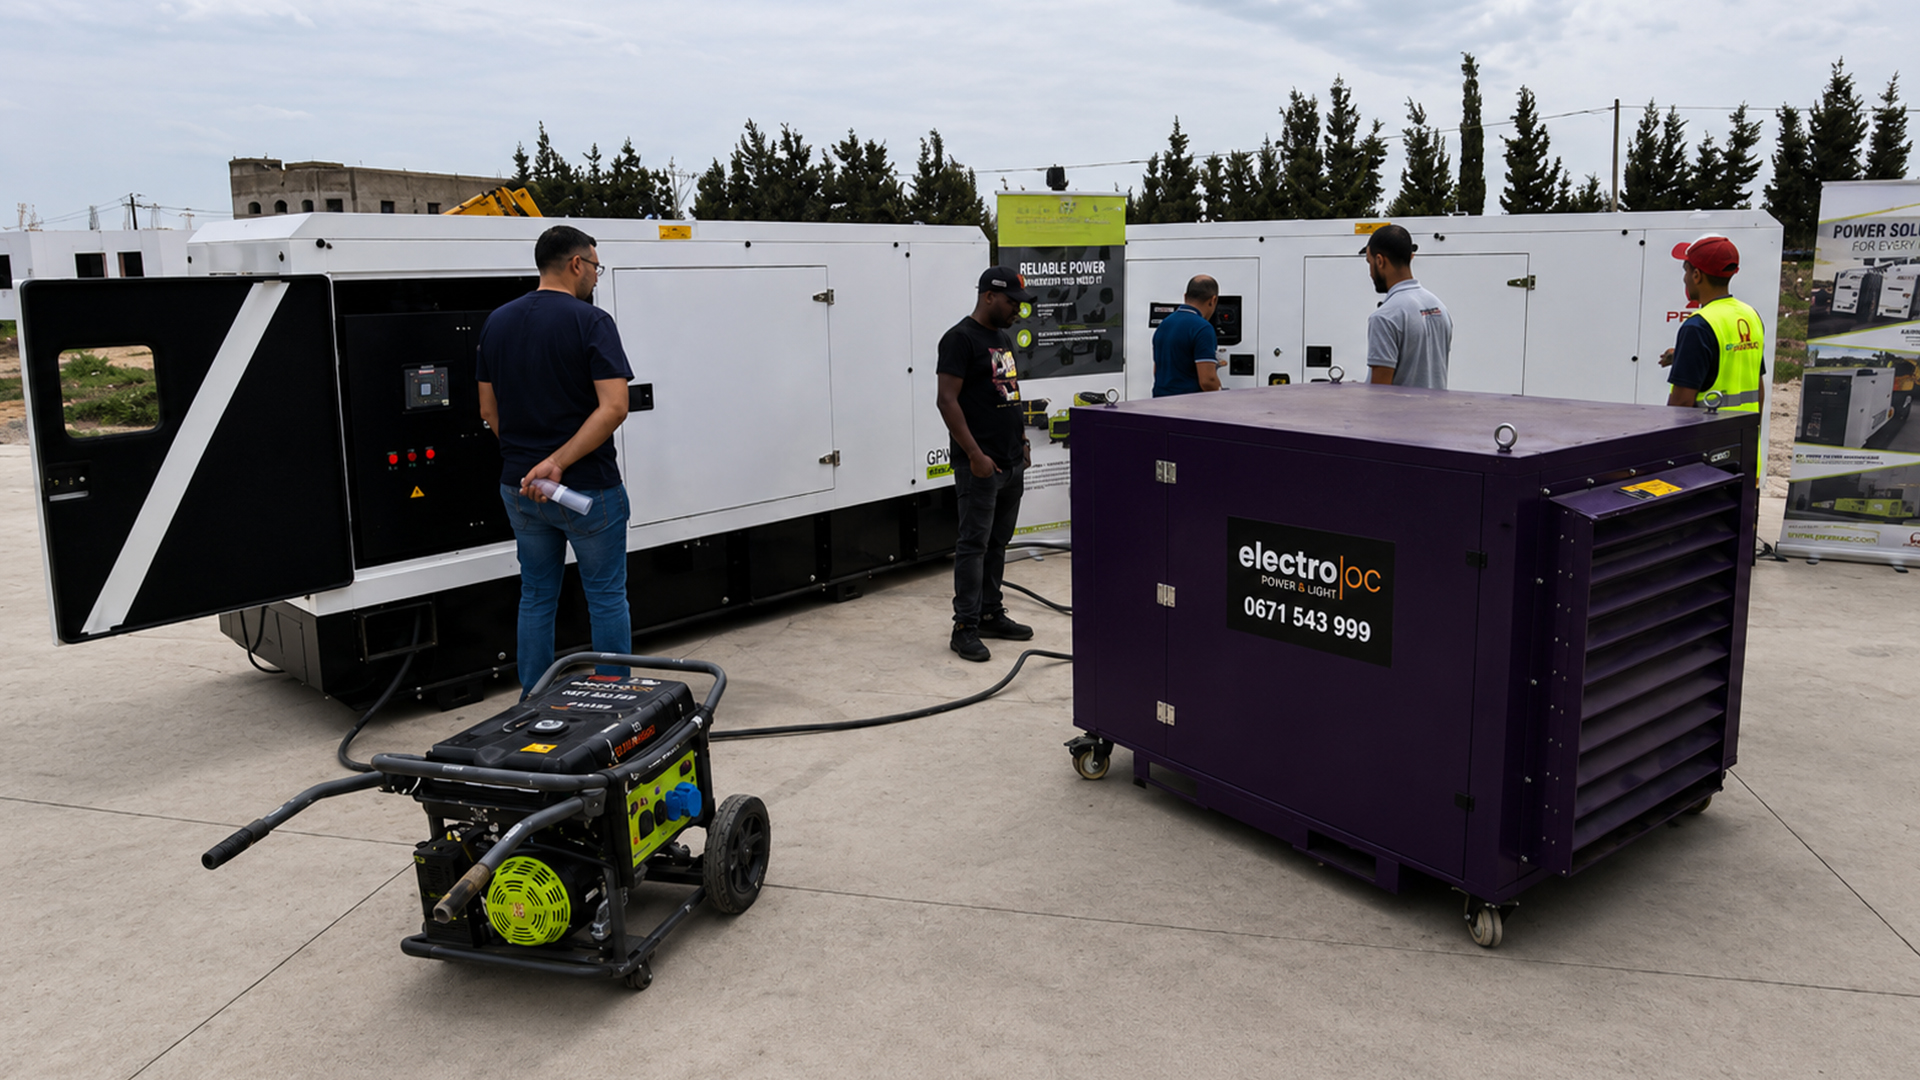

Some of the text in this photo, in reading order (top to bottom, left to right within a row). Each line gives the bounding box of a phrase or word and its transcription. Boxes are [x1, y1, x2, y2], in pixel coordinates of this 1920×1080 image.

[1833, 222, 1920, 239] POWER SOL
[1852, 240, 1916, 252] FOR EVERY
[1020, 261, 1106, 275] RELIABLE POWER
[1261, 575, 1296, 591] POWER
[1307, 584, 1337, 599] LIGHT
[1244, 596, 1372, 642] 0671 543 999
